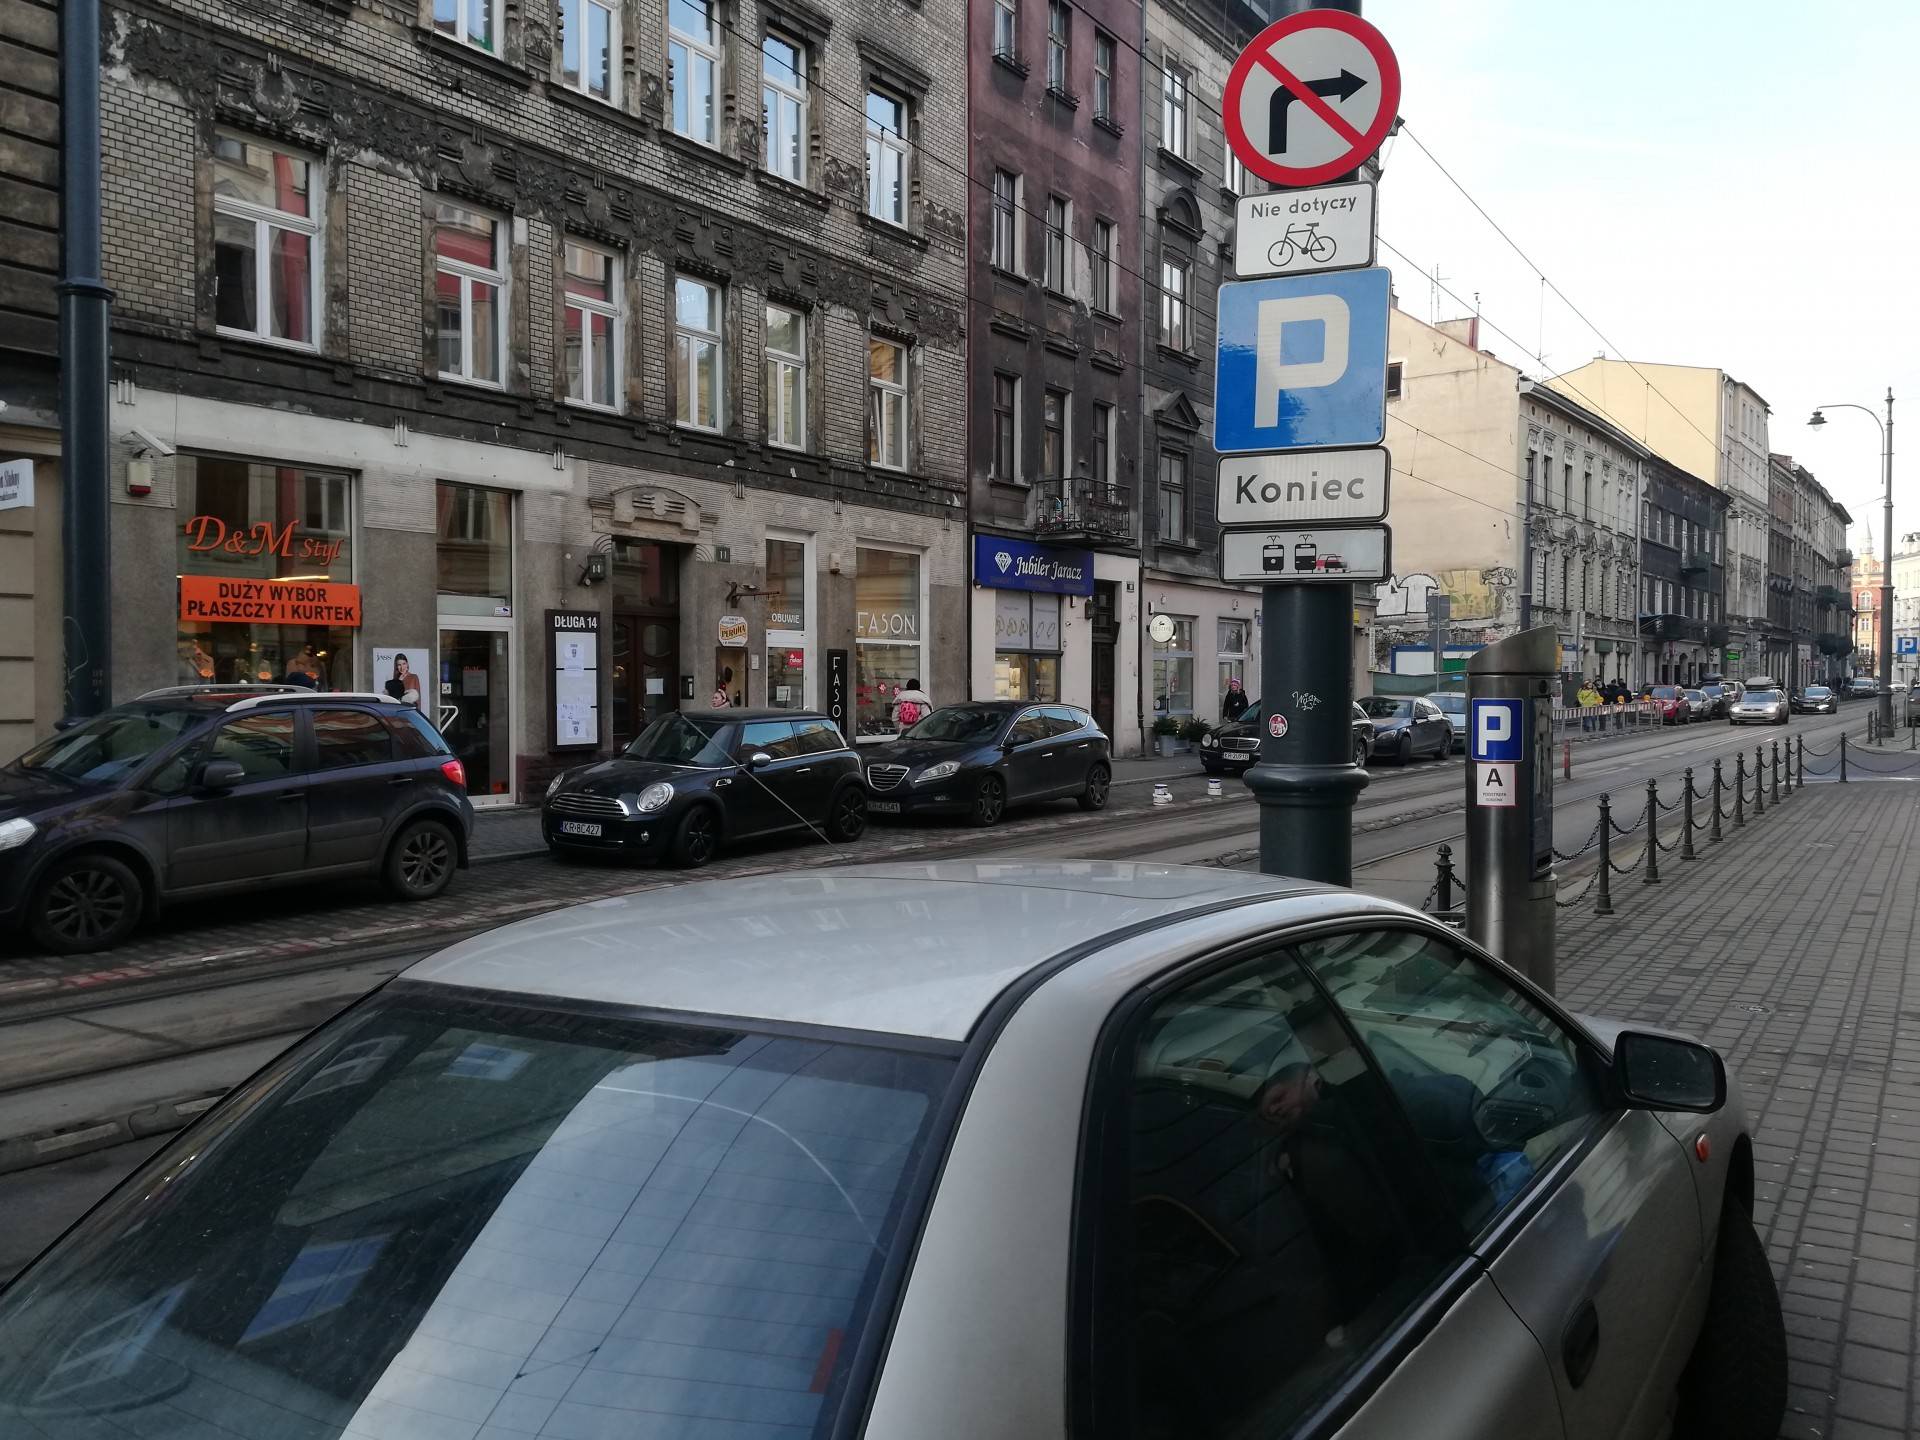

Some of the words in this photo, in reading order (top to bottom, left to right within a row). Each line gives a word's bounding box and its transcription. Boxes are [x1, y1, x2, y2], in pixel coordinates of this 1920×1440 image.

[1250, 202, 1281, 219] Nie
[1288, 196, 1357, 216] dotyczy
[1254, 294, 1350, 428] P
[1235, 471, 1365, 505] Koniec
[185, 515, 300, 557] D&M
[300, 538, 344, 566] Styl
[1014, 556, 1050, 577] Jubiler
[1050, 561, 1082, 581] Jaracz
[218, 581, 264, 599] DUŻY
[269, 584, 327, 603] WYBÓR
[187, 600, 275, 619] PŁASZCZY
[280, 606, 286, 619] I
[291, 605, 354, 621] KURTEK
[771, 613, 800, 624] OBUWIE
[554, 615, 585, 628] DŁUGA
[586, 617, 598, 629] 14
[1901, 638, 1914, 652] P
[1478, 705, 1511, 756] P
[1486, 767, 1503, 787] A
